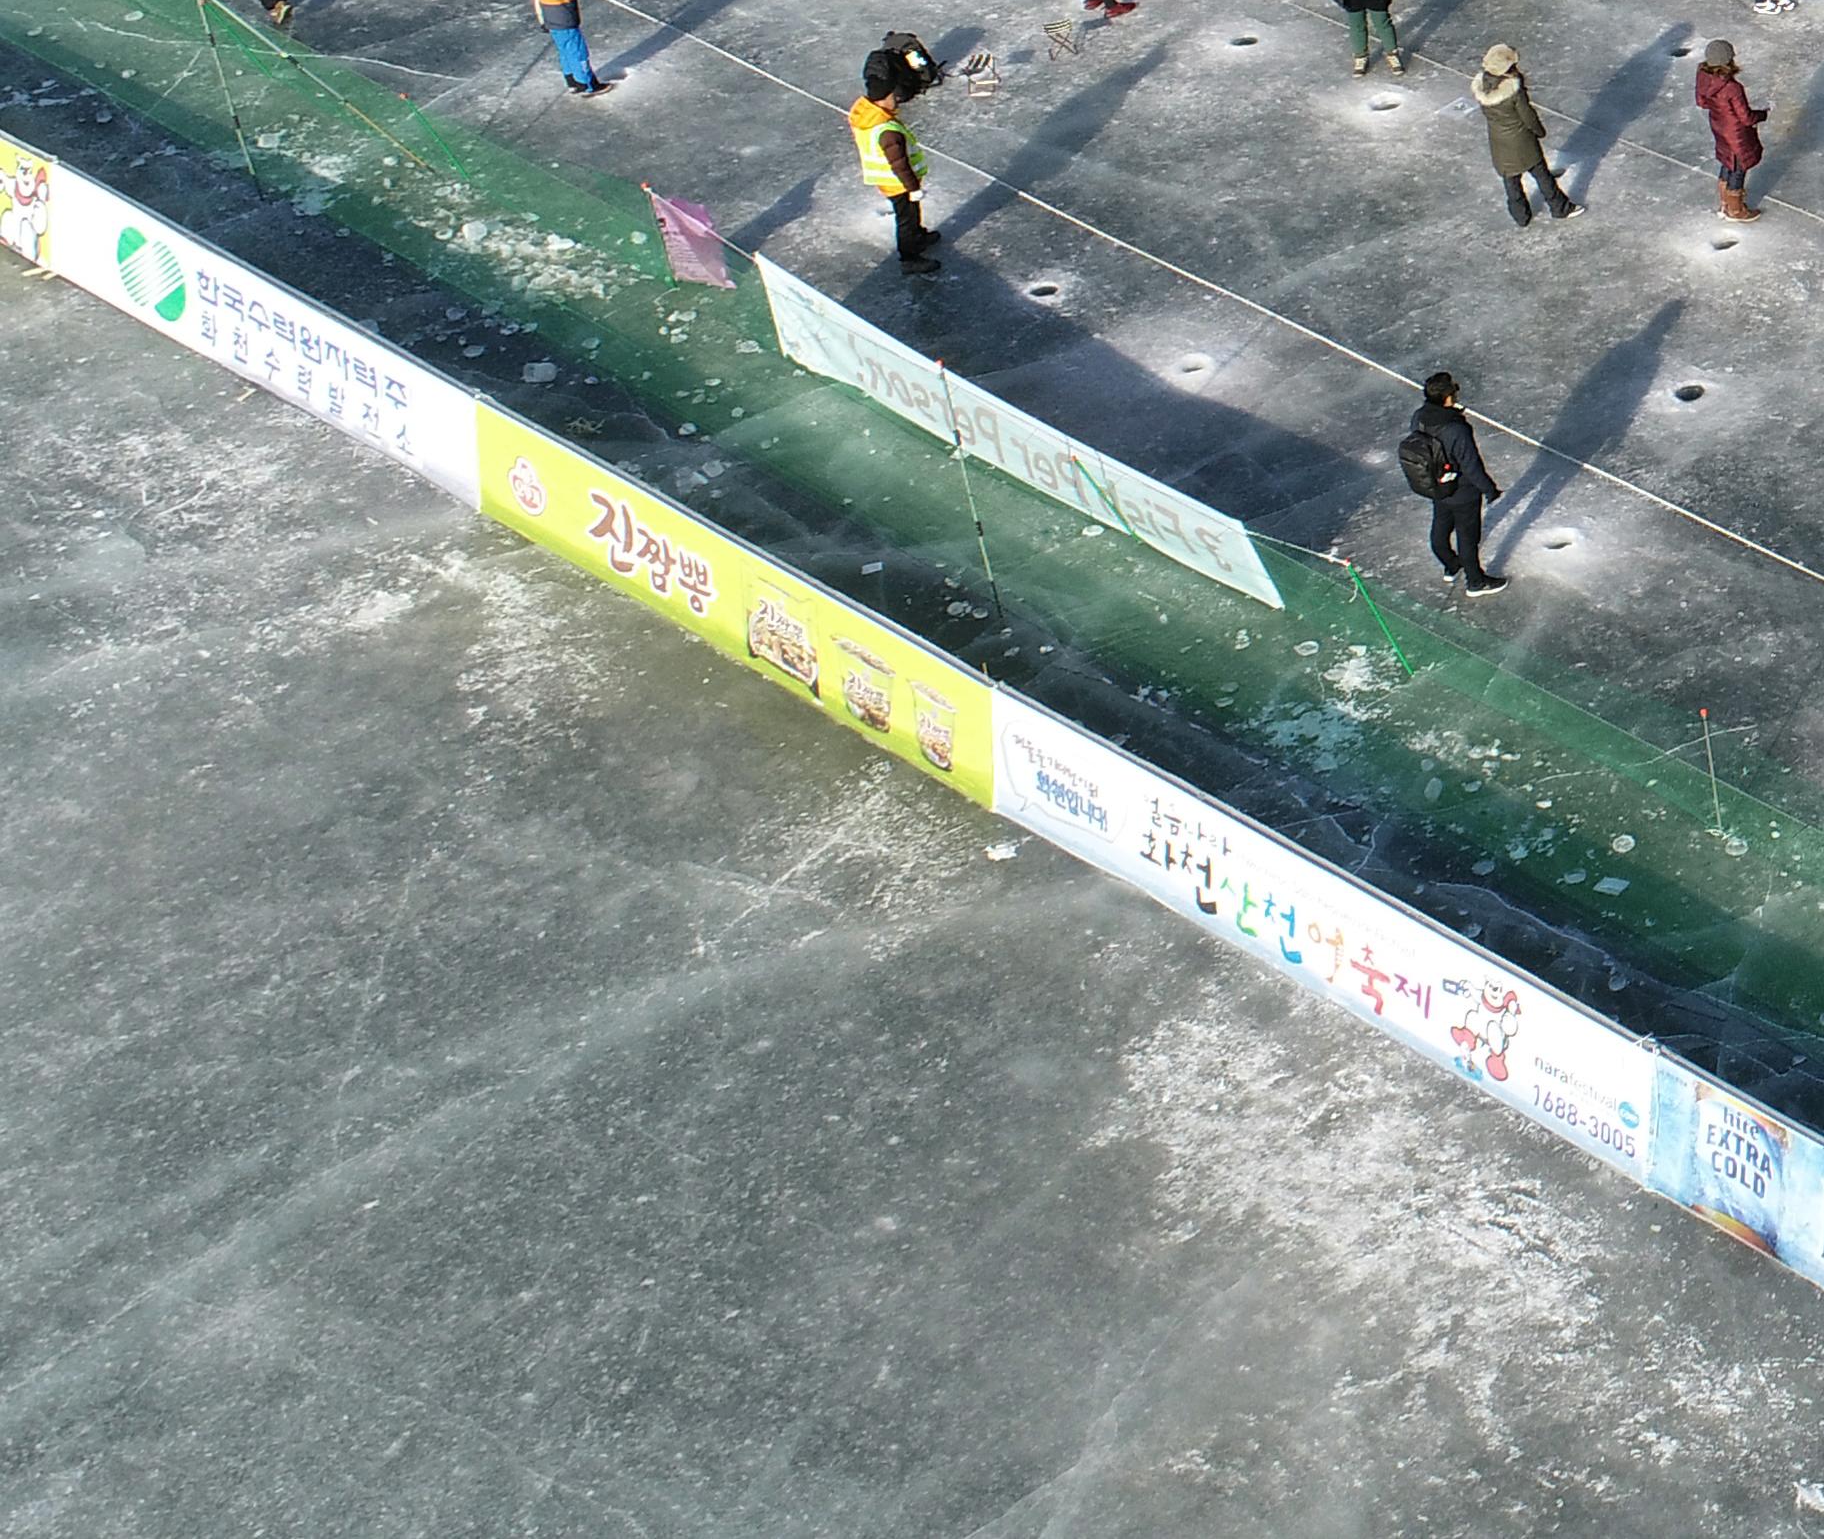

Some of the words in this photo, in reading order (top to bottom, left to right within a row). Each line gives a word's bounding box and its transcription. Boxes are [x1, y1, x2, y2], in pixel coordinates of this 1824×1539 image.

[588, 491, 717, 616] 진짬뽕
[1035, 768, 1109, 834] 화천입니다!
[1139, 829, 1433, 1021] 화천산천어축제
[1532, 1083, 1637, 1159] 1688-3005
[1705, 1122, 1774, 1181] EXTRA
[1722, 1106, 1761, 1141] hite
[1710, 1150, 1767, 1200] COLD
